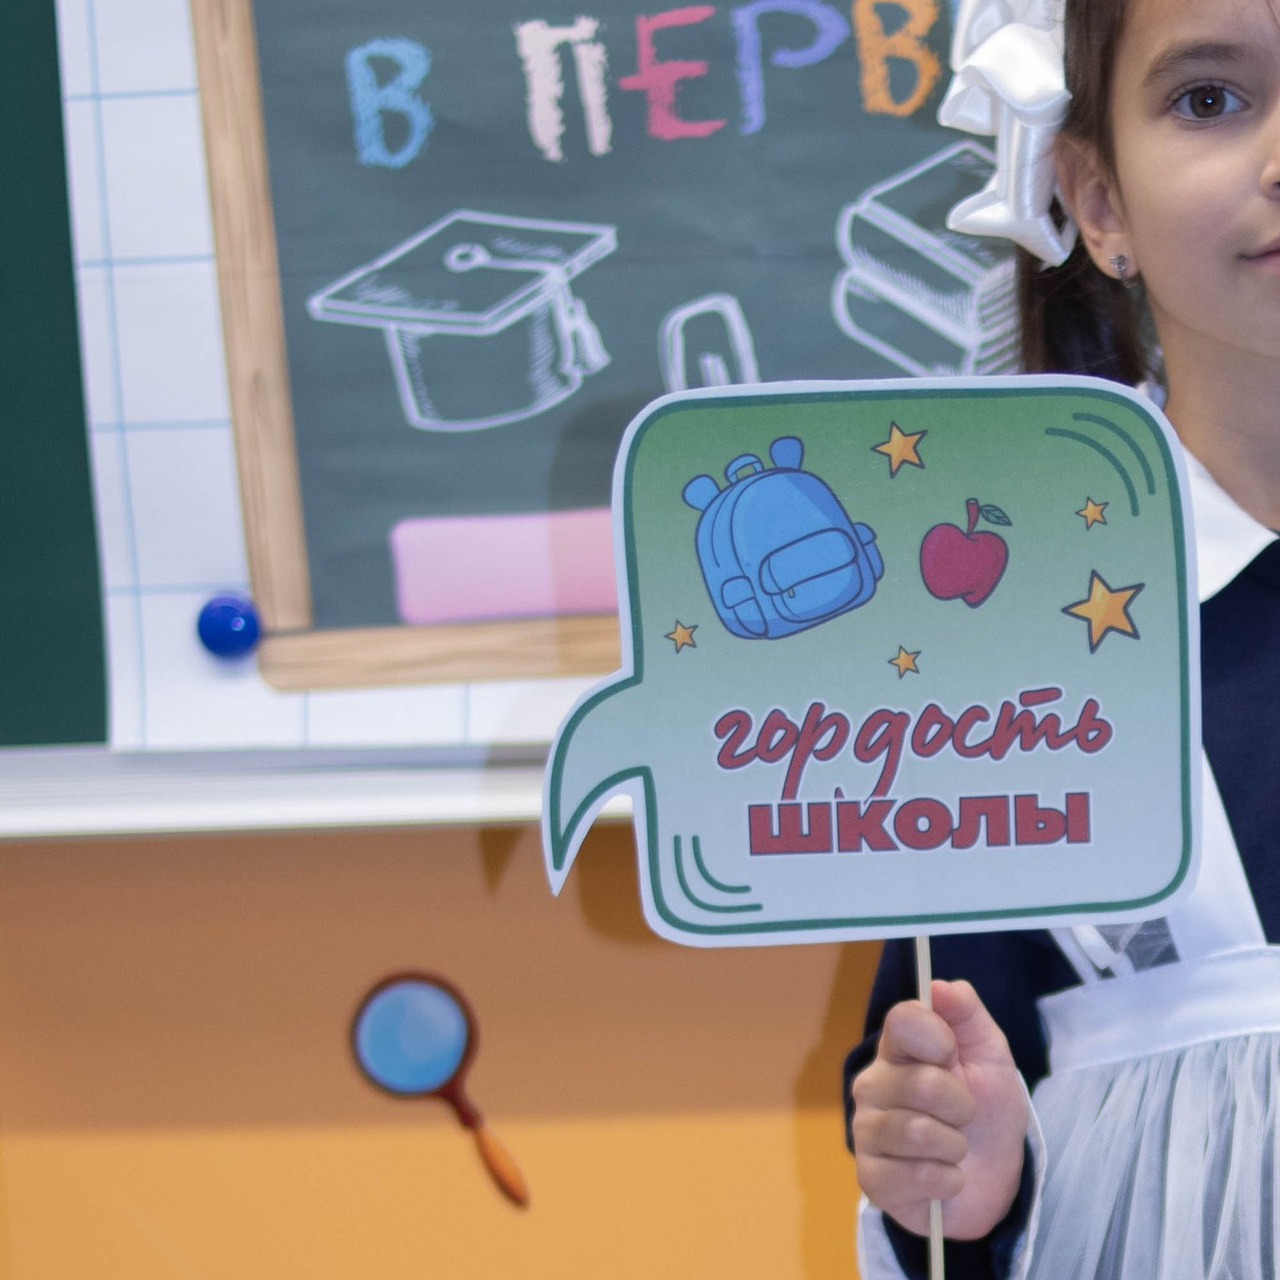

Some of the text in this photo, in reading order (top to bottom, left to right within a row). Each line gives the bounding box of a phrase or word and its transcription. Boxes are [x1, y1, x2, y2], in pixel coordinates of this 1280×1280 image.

[345, 0, 956, 168] В ПЕРВ
[713, 687, 1114, 800] гордость
[748, 791, 1092, 856] школы
